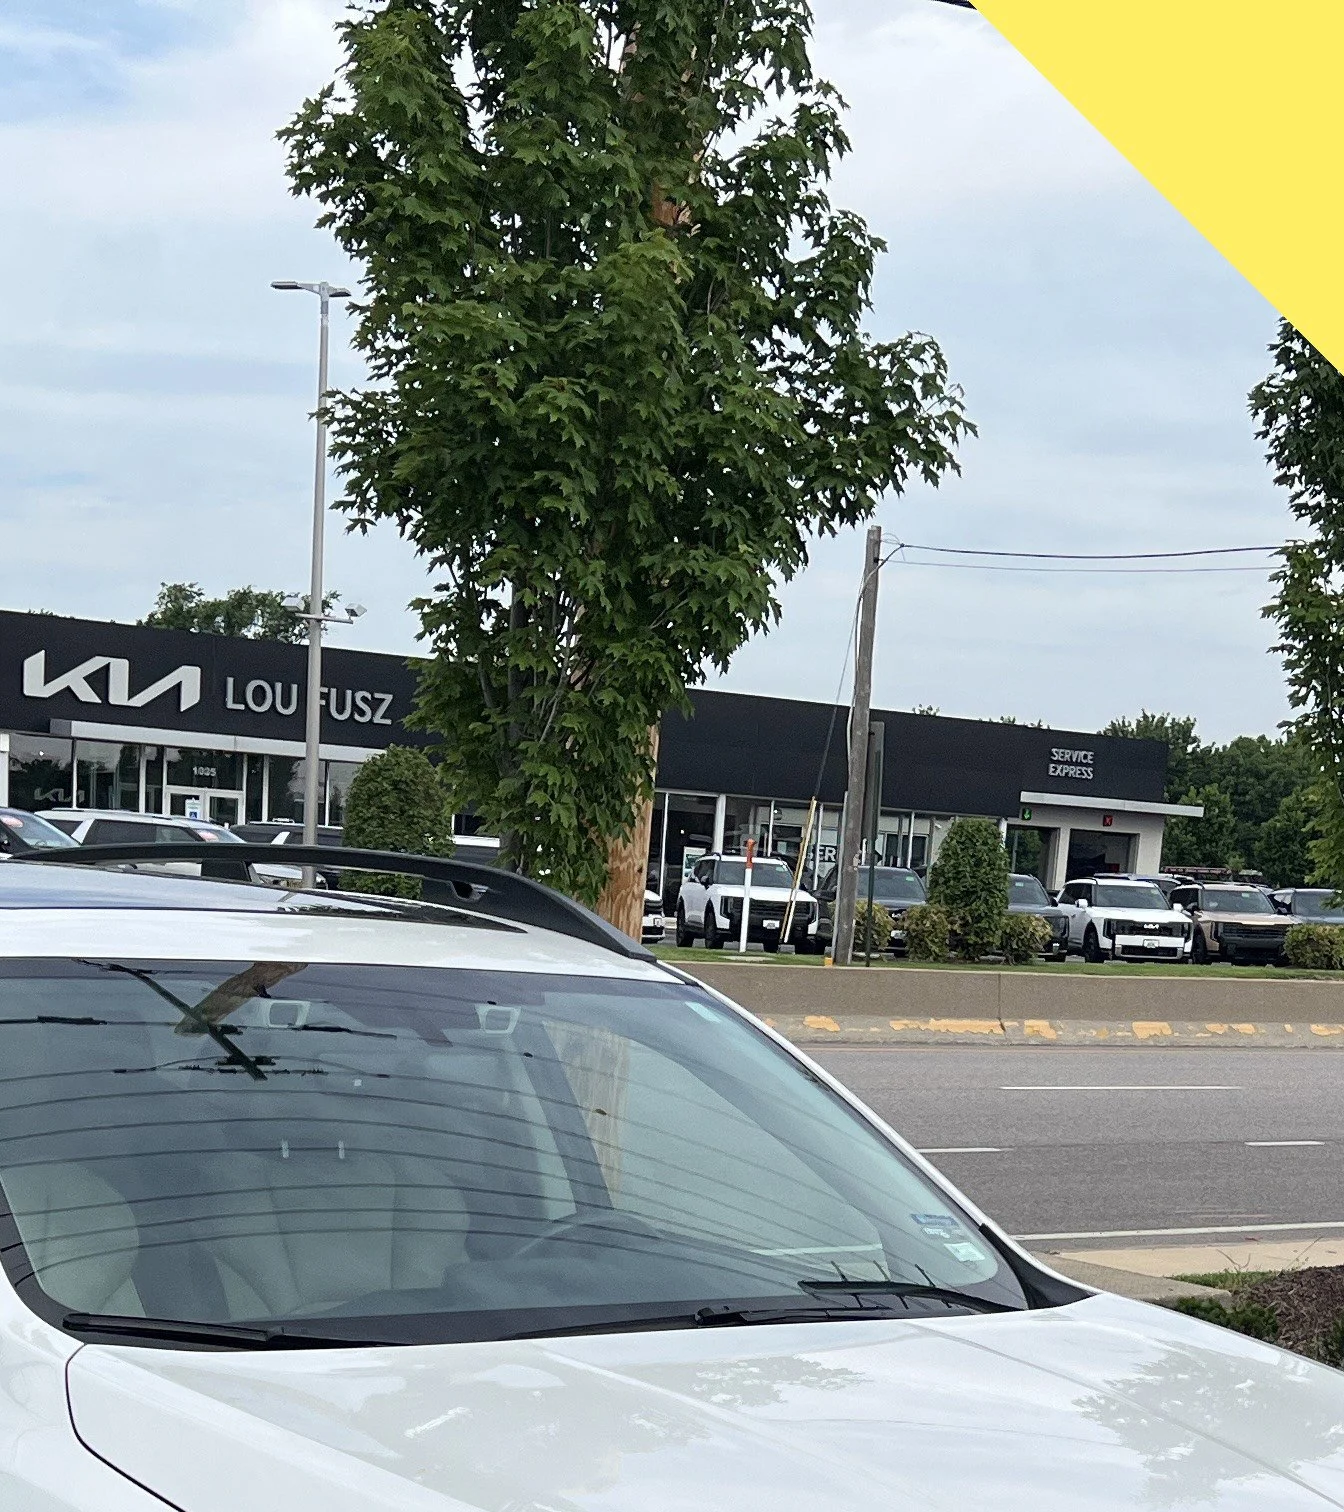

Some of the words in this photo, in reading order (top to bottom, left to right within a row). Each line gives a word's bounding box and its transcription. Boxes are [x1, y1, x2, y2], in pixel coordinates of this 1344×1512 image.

[225, 676, 299, 716] LOU
[1050, 747, 1095, 764] SERVICE
[1048, 763, 1094, 780] EXPRESS
